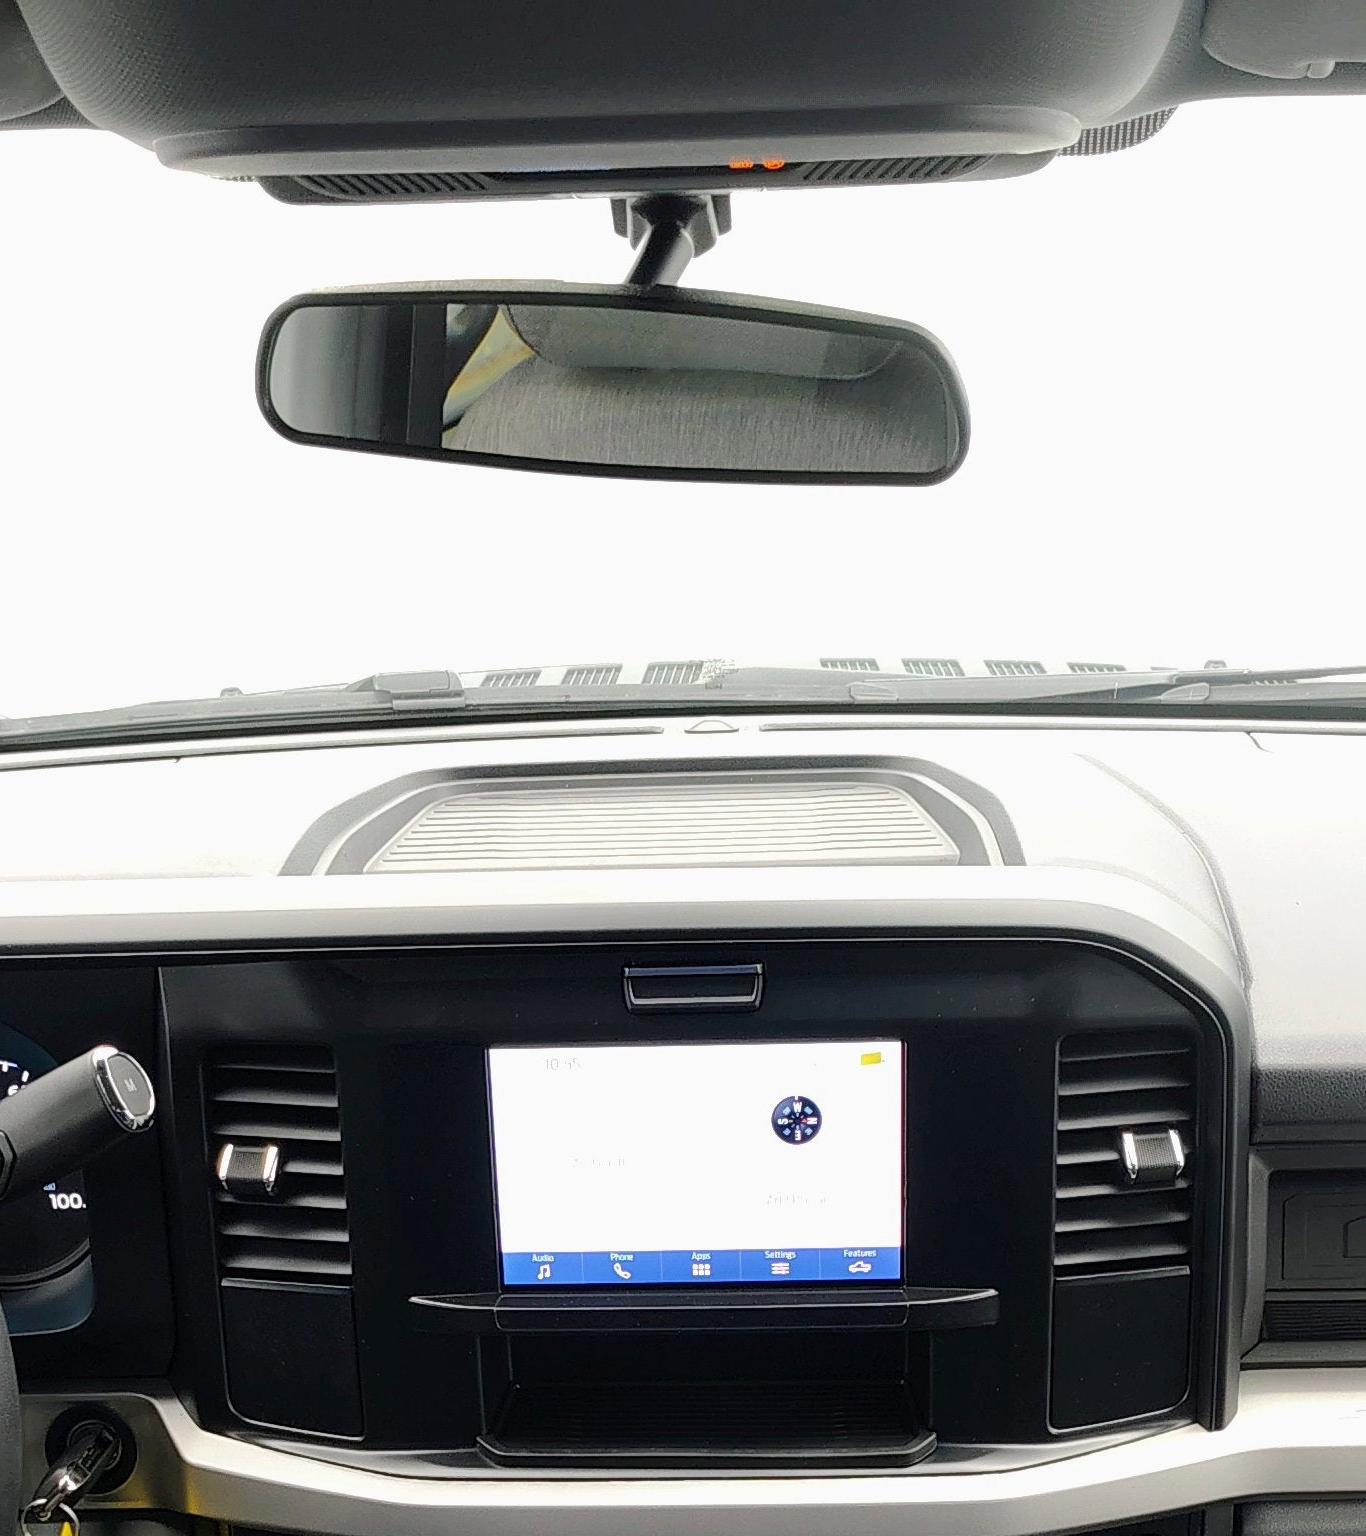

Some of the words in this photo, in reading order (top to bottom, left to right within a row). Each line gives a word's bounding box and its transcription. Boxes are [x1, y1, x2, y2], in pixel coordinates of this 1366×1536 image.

[531, 1253, 555, 1263] Audio
[610, 1252, 634, 1262] Phone
[691, 1250, 711, 1262] Apps
[764, 1249, 797, 1261] Settings
[842, 1248, 877, 1258] Features
